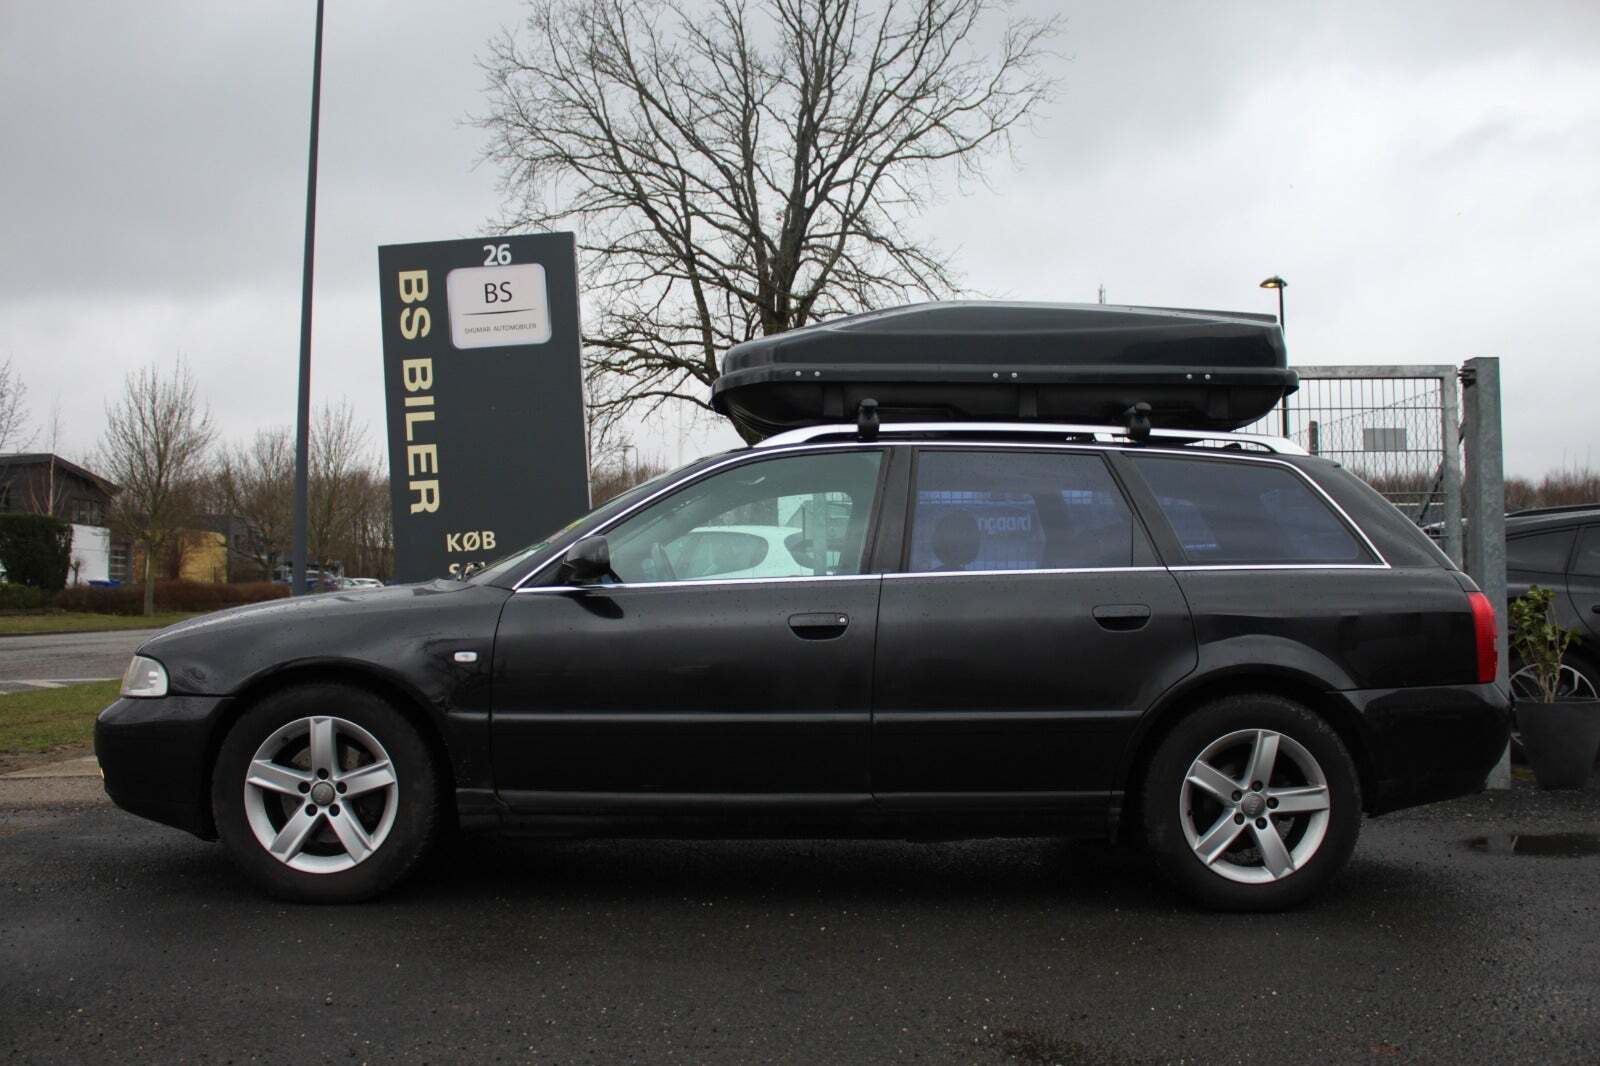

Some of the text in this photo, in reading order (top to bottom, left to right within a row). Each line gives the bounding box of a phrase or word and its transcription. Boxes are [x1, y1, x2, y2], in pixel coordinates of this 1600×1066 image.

[483, 244, 512, 266] 26
[484, 281, 513, 304] BS
[493, 323, 537, 331] AUTOMOBILER
[398, 269, 441, 515] BS BILER
[446, 531, 497, 553] KØB
